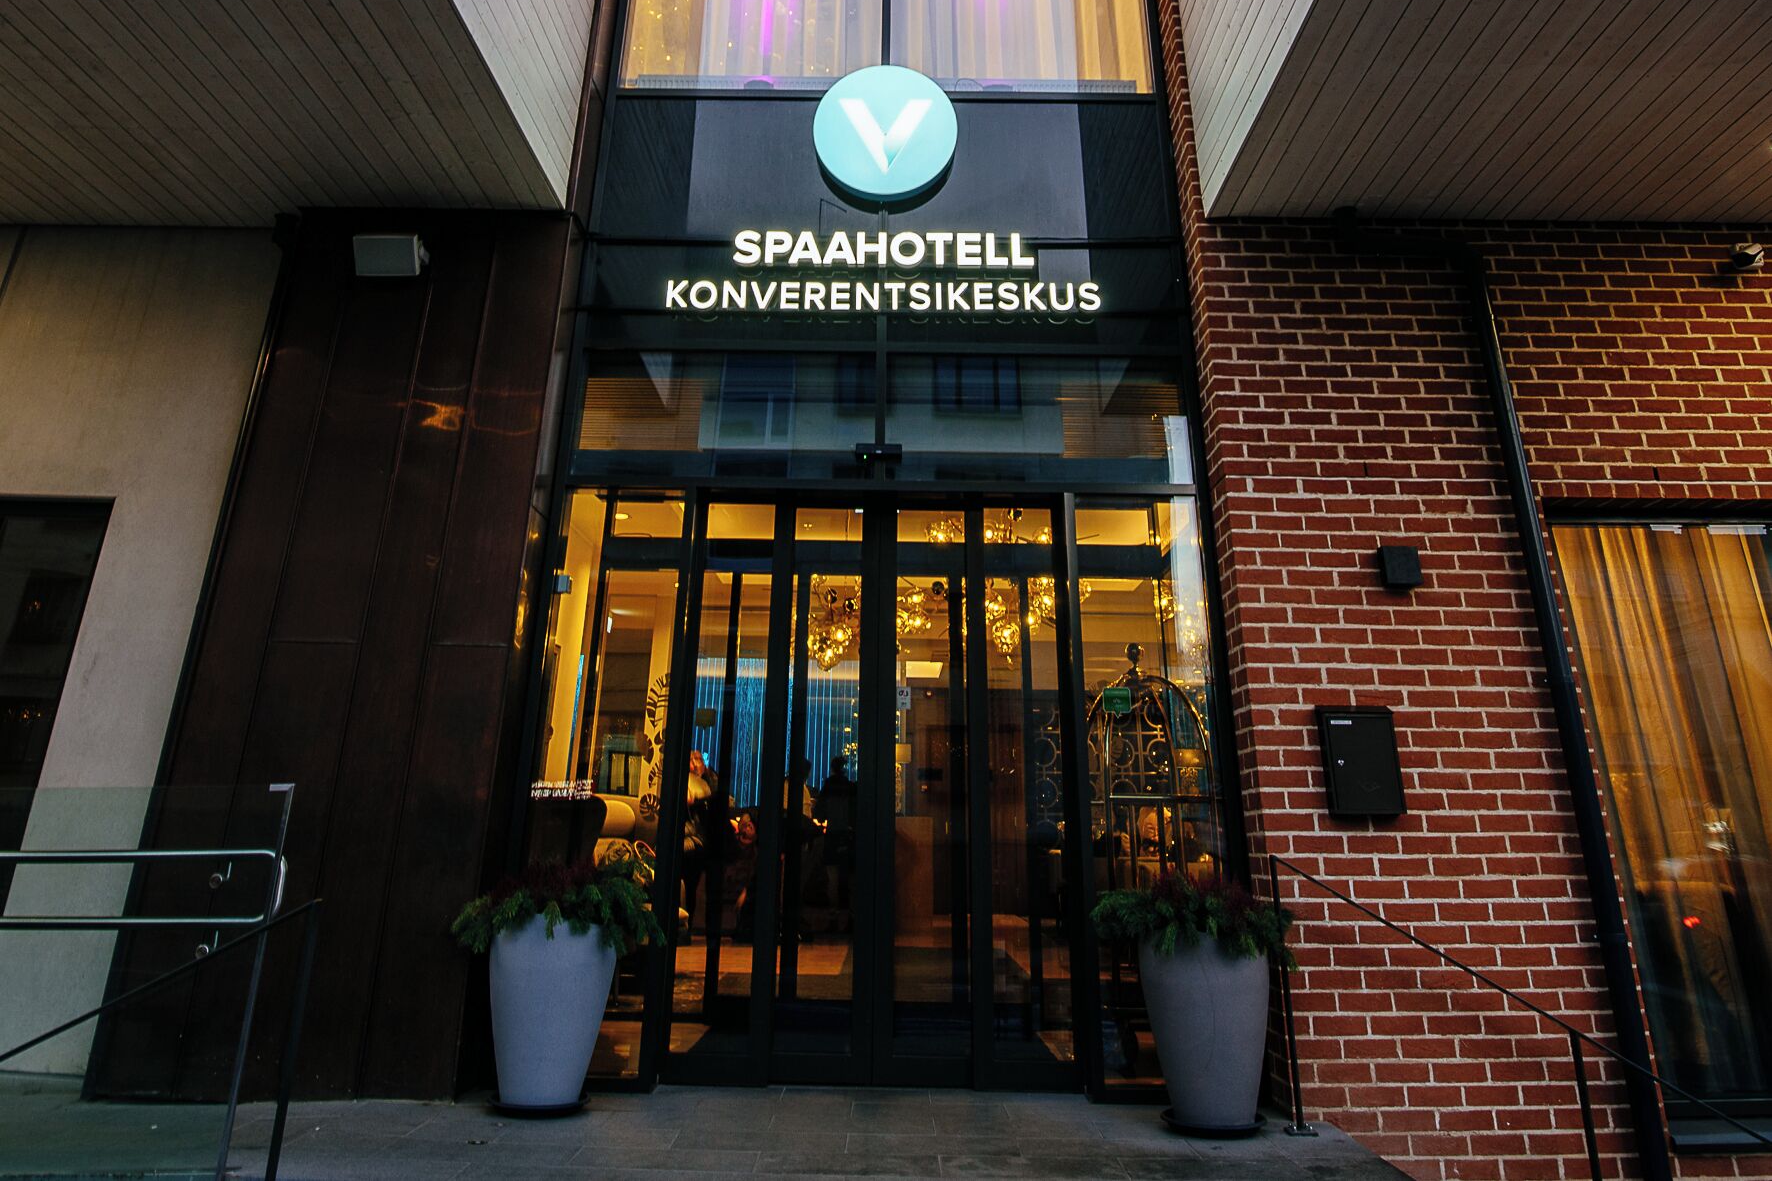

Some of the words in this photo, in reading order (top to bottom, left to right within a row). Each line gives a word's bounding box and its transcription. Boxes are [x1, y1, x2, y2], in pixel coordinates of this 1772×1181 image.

[839, 98, 933, 175] V
[732, 229, 1035, 267] SPAAHOTELL
[665, 280, 1102, 312] KONVERENTSIKESKUS
